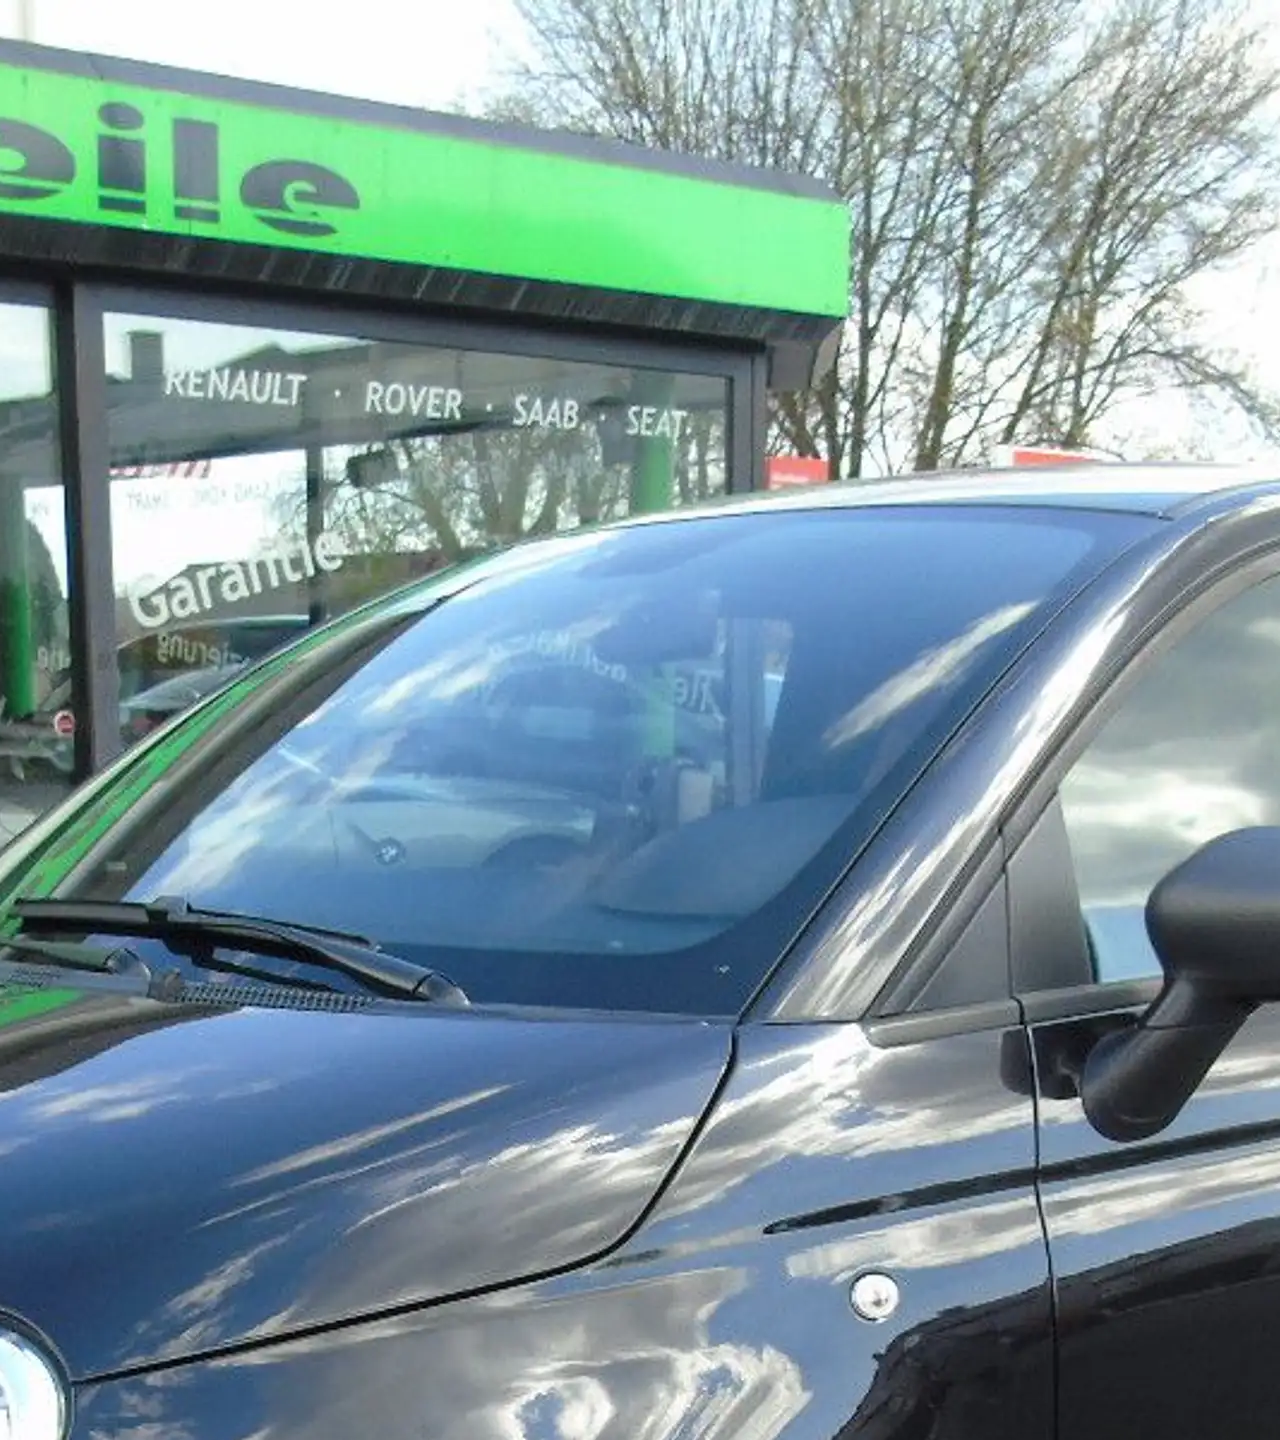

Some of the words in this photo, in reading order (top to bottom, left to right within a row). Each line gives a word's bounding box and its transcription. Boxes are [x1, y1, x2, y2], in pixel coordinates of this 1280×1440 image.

[163, 367, 308, 407] RENAULT
[365, 381, 462, 420] ROVER
[512, 395, 580, 430] SAAB
[626, 404, 687, 441] SEAT
[128, 529, 349, 629] Garantie
